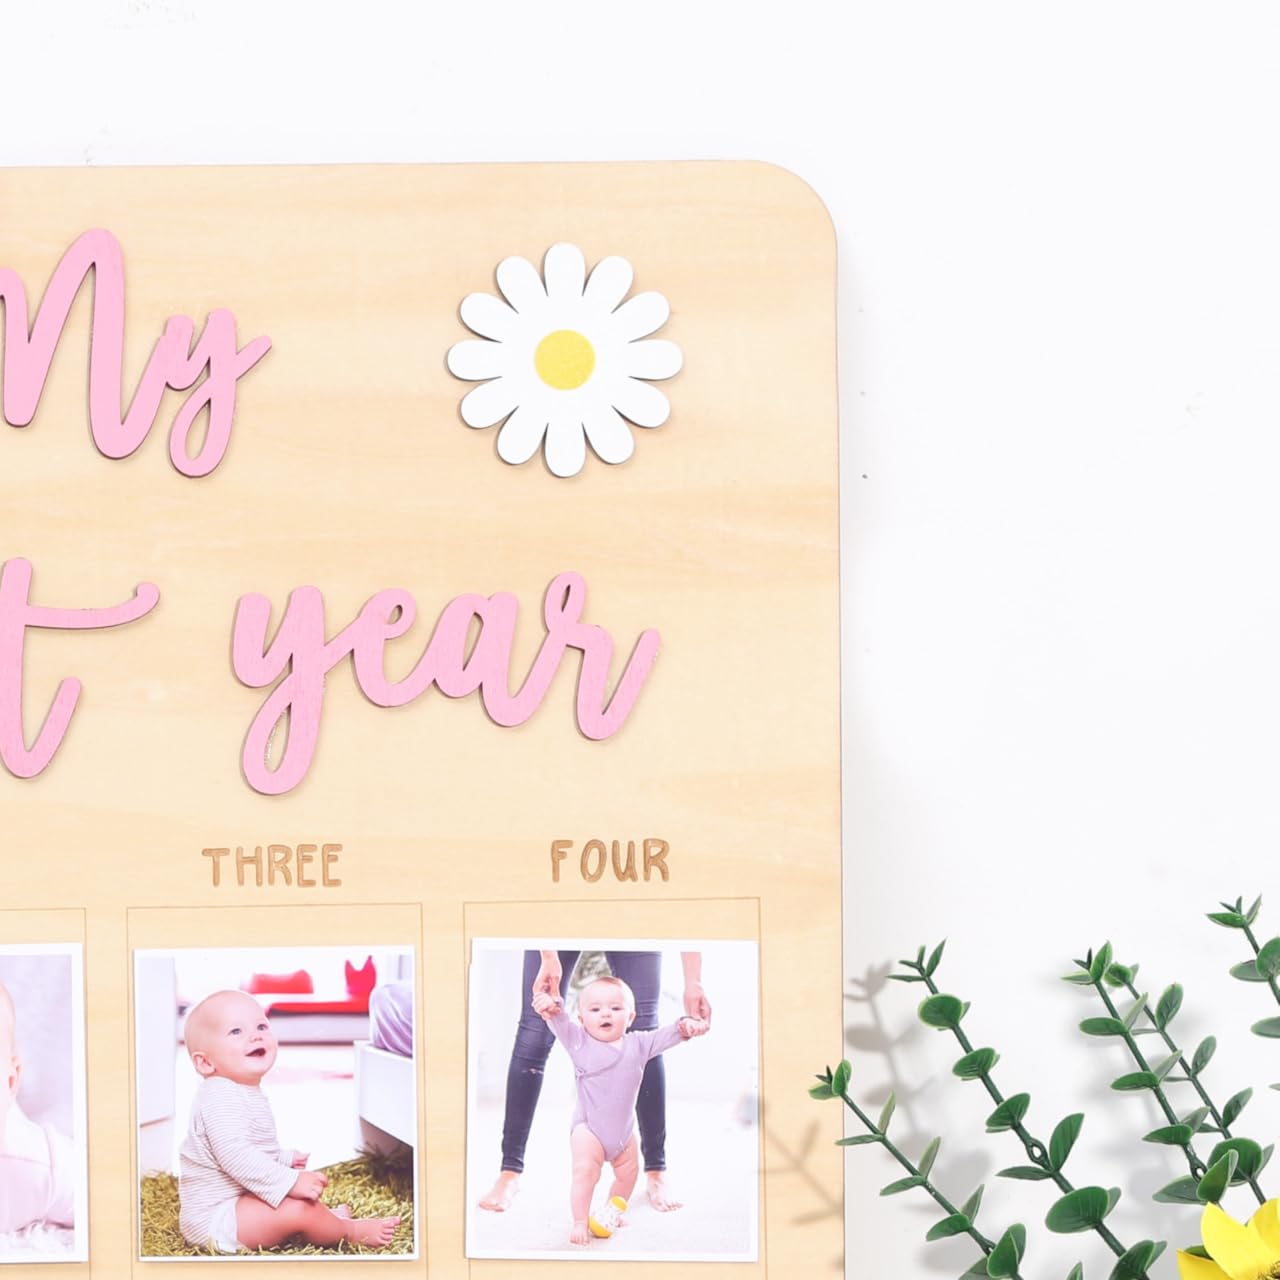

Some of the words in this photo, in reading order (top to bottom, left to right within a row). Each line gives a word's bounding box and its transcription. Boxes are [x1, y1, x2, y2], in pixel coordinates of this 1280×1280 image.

[232, 571, 661, 795] year
[201, 843, 343, 888] THREE
[550, 838, 670, 883] FOUR
